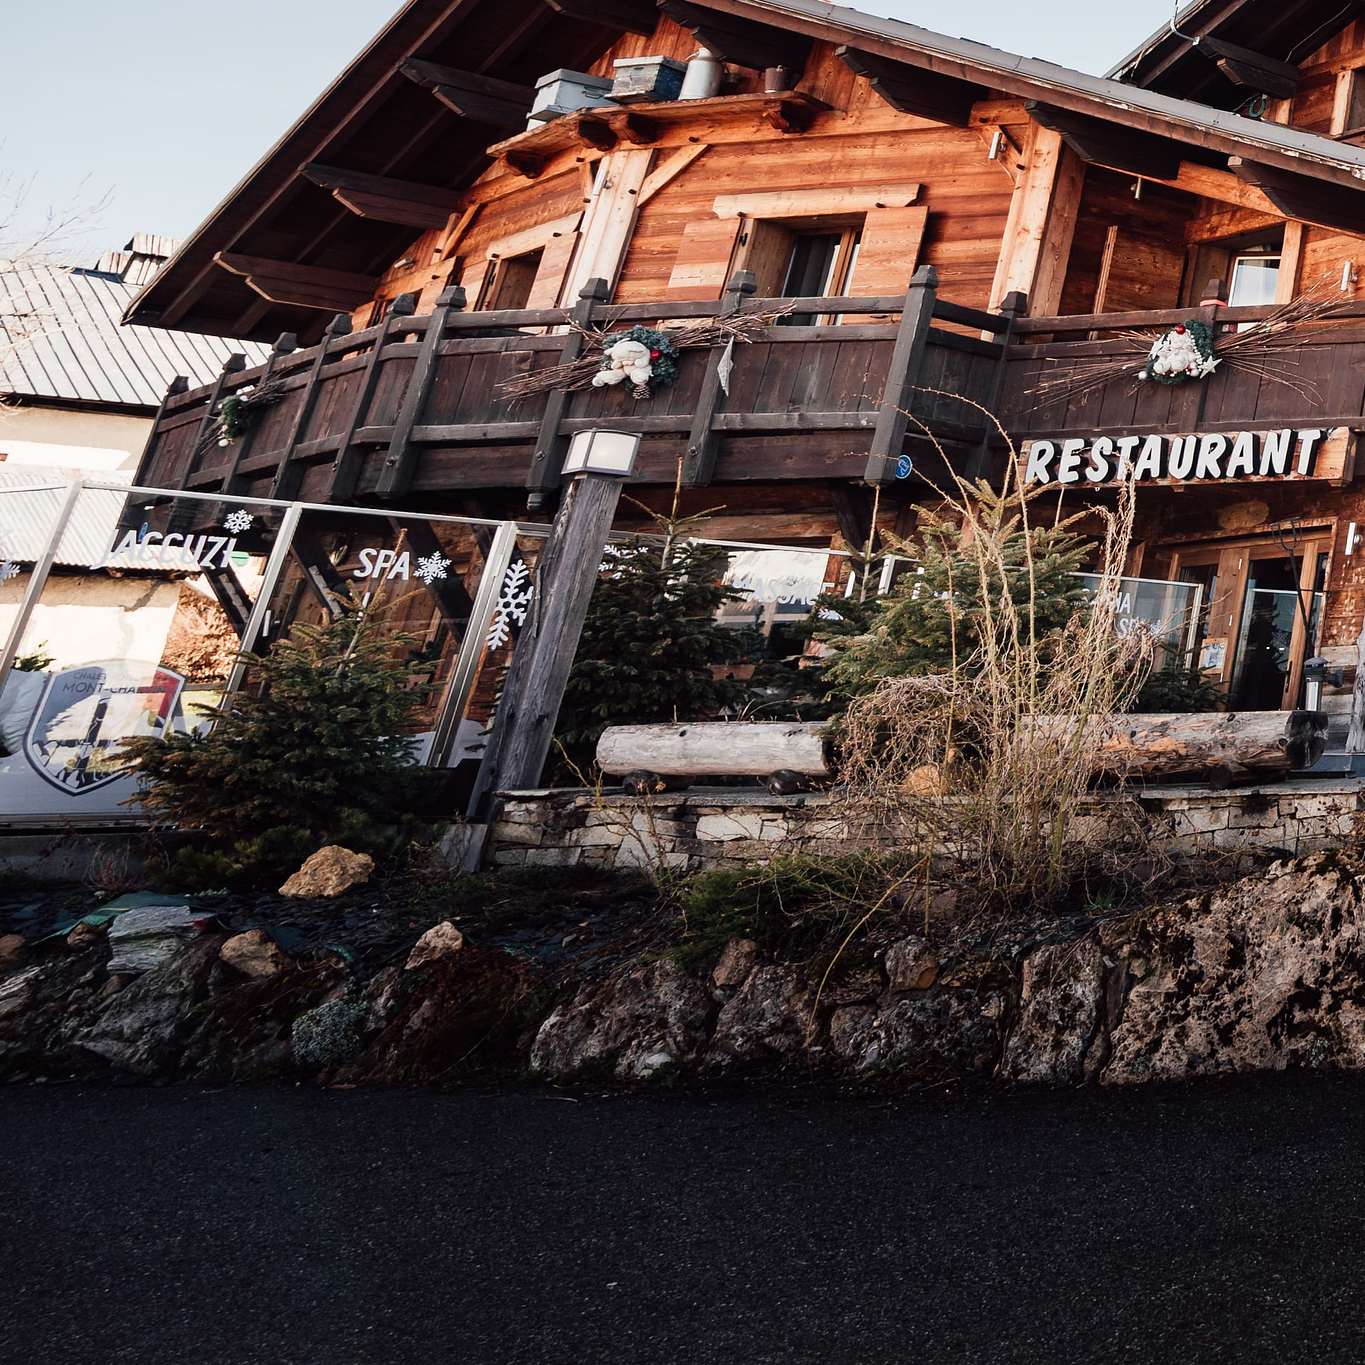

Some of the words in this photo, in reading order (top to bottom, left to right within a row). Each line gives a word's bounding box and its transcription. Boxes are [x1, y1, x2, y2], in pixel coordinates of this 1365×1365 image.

[1024, 429, 1322, 484] RESTAURANT
[90, 529, 238, 571] JACCUZI
[354, 547, 410, 581] SPA
